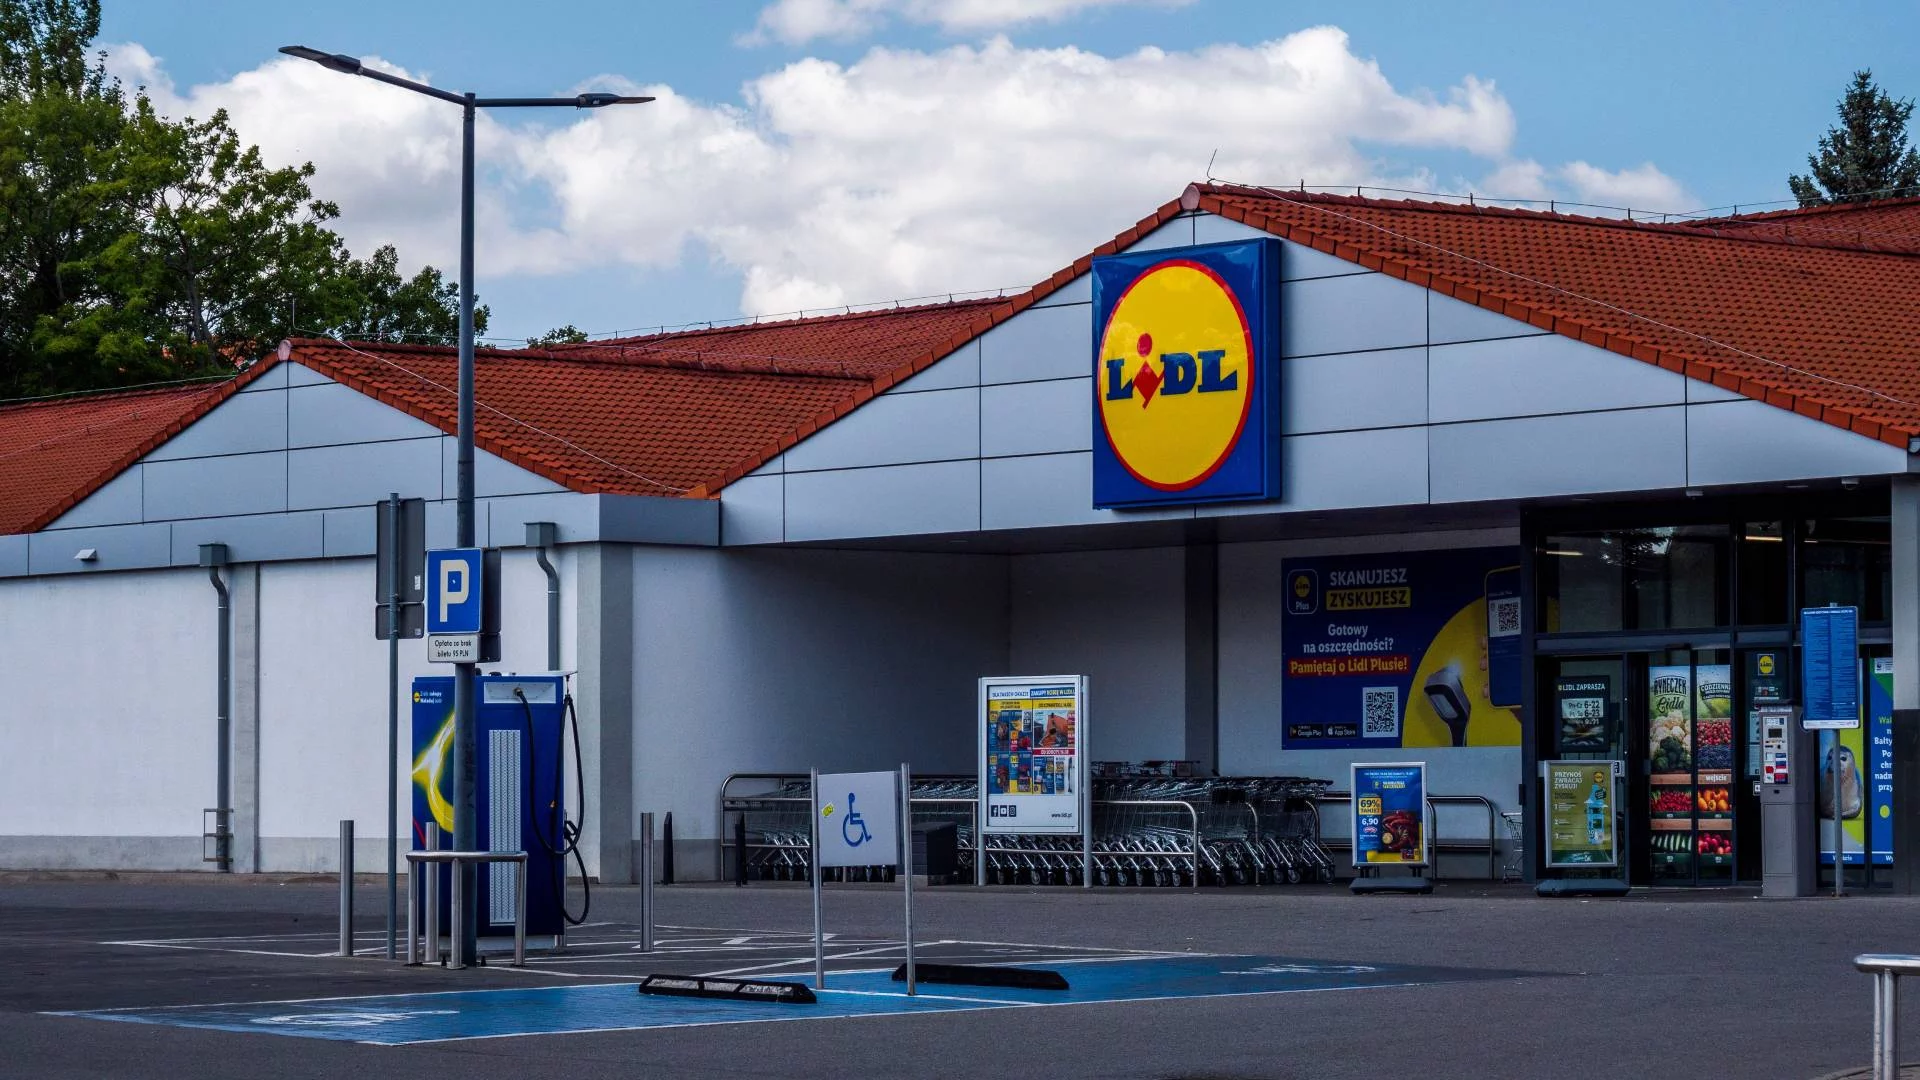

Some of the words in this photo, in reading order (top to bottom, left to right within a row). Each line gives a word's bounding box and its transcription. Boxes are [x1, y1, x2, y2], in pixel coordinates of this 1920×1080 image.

[1329, 568, 1408, 587] SKANUJESZ
[440, 559, 469, 622] P
[1330, 589, 1407, 607] ZYSKUJESZ
[1328, 623, 1369, 638] Gotowy
[1303, 643, 1316, 653] na
[1318, 637, 1394, 655] oszczędności?
[1290, 658, 1337, 676] Pamiętaj
[1338, 662, 1346, 672] o
[1347, 657, 1368, 672] Lidl
[1370, 656, 1408, 671] Plusie!
[1654, 677, 1687, 695] RYNECZEK
[1584, 701, 1600, 709] 6-22
[1584, 709, 1600, 717] 6-23
[1705, 774, 1727, 782] wejście
[1360, 799, 1380, 808] 69%
[1361, 818, 1379, 826] 6,90
